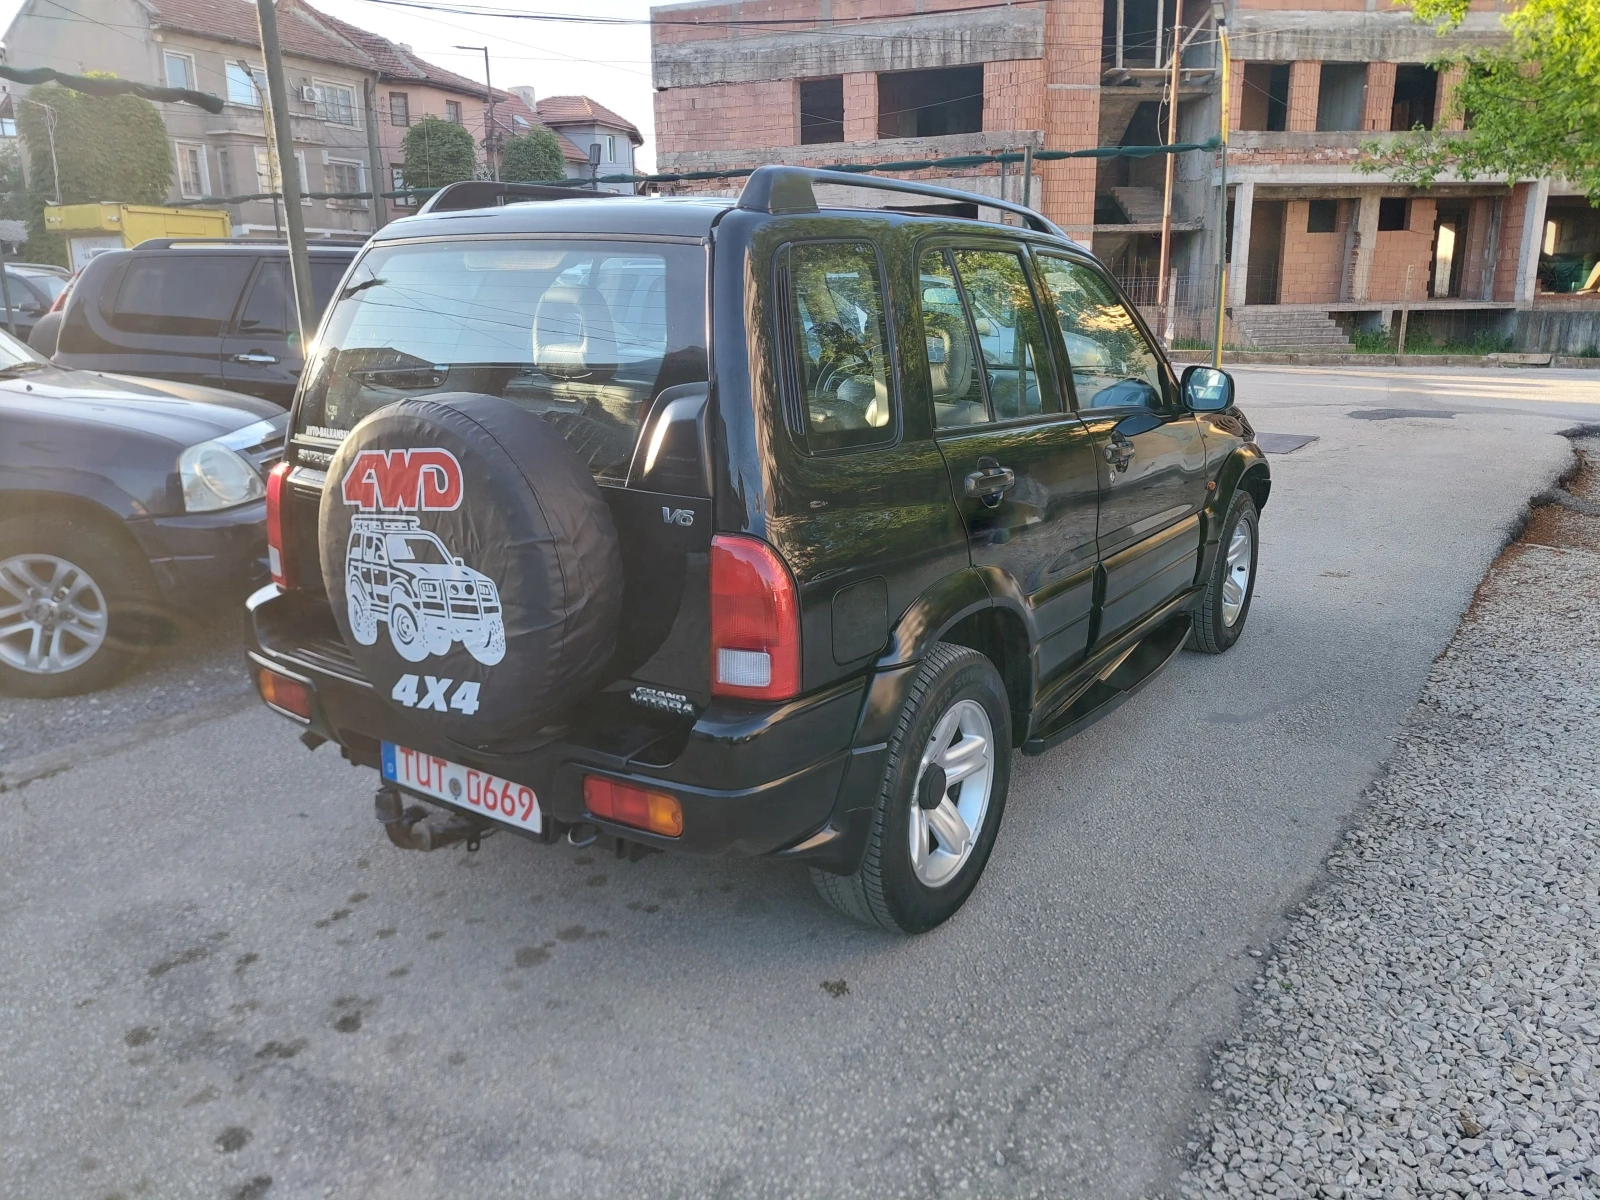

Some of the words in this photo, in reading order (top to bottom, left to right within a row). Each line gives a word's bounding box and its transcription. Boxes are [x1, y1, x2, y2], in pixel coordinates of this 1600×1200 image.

[341, 447, 464, 511] 4WD
[662, 506, 695, 526] V6
[392, 673, 481, 715] 4X4
[630, 692, 695, 716] VITARA
[635, 686, 687, 701] GRAND
[400, 746, 447, 793] TUT
[467, 769, 534, 821] 0669
